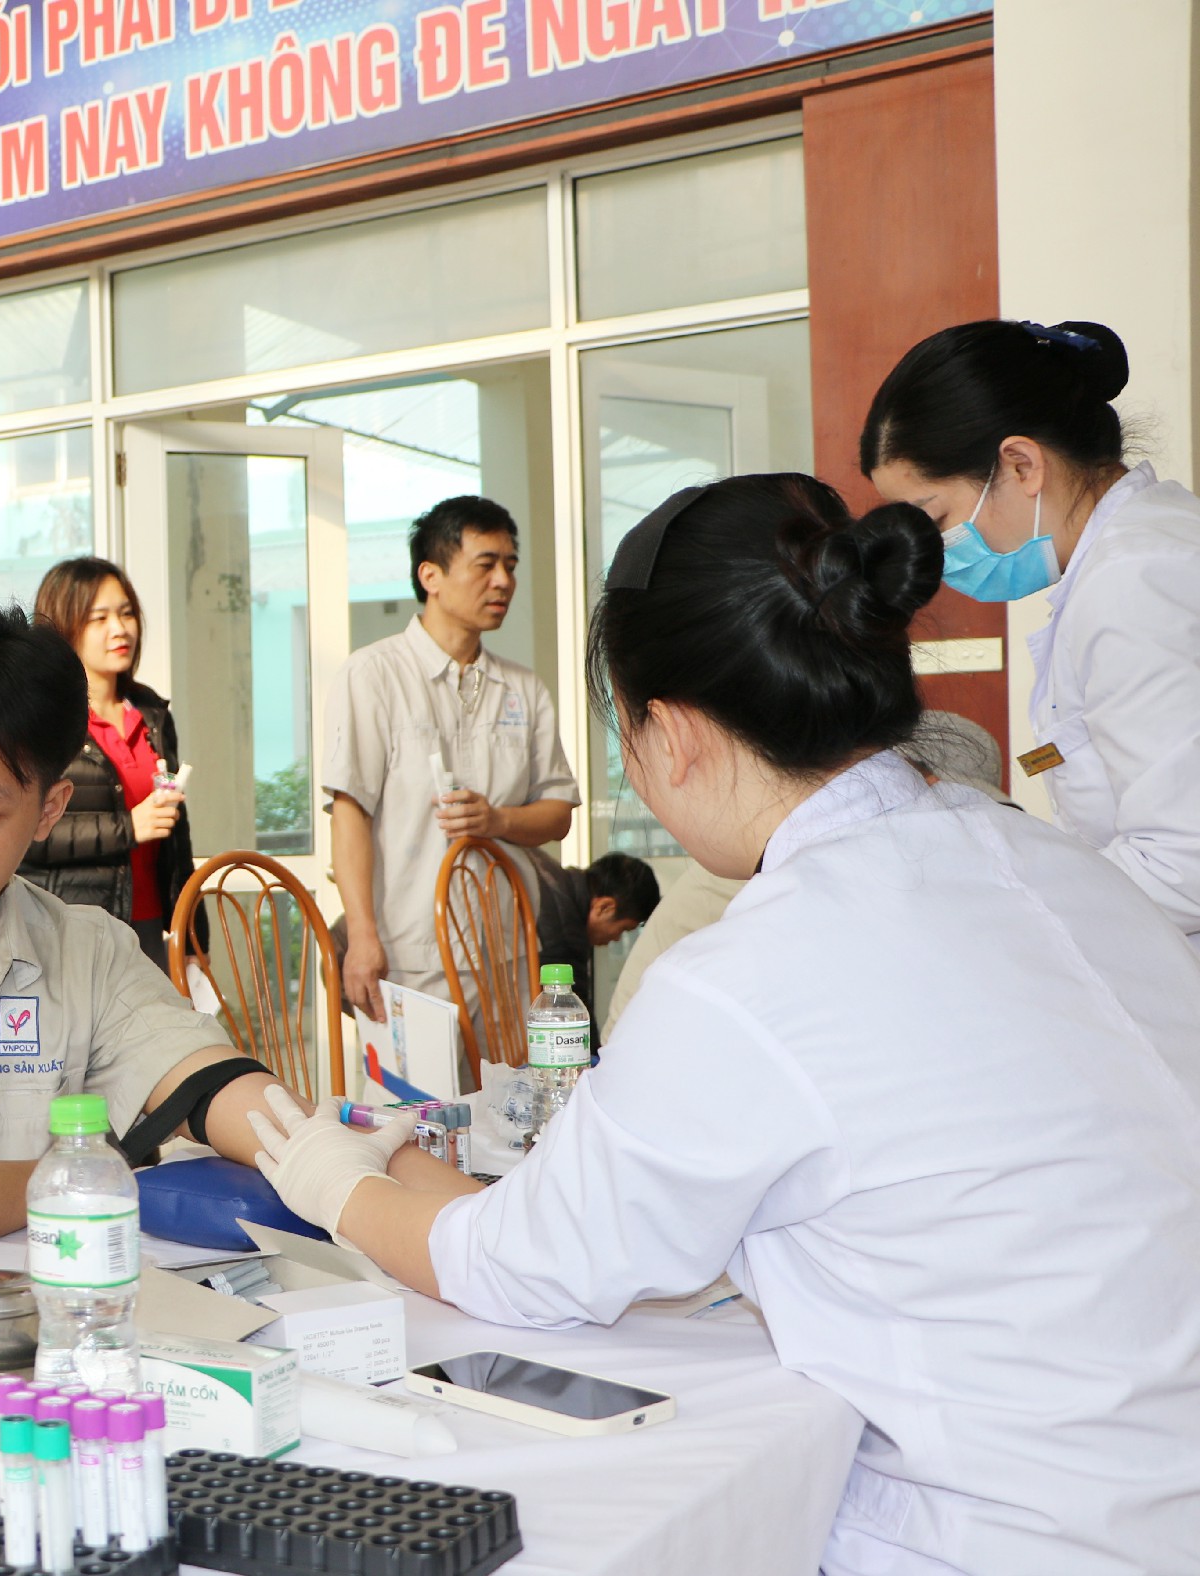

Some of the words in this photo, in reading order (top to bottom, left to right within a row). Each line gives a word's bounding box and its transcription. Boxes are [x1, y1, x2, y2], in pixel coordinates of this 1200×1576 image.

[63, 84, 169, 189] NAY
[186, 23, 400, 158] KHÔNG
[13, 1060, 35, 1074] SẢN
[38, 1059, 65, 1074] XUẤT
